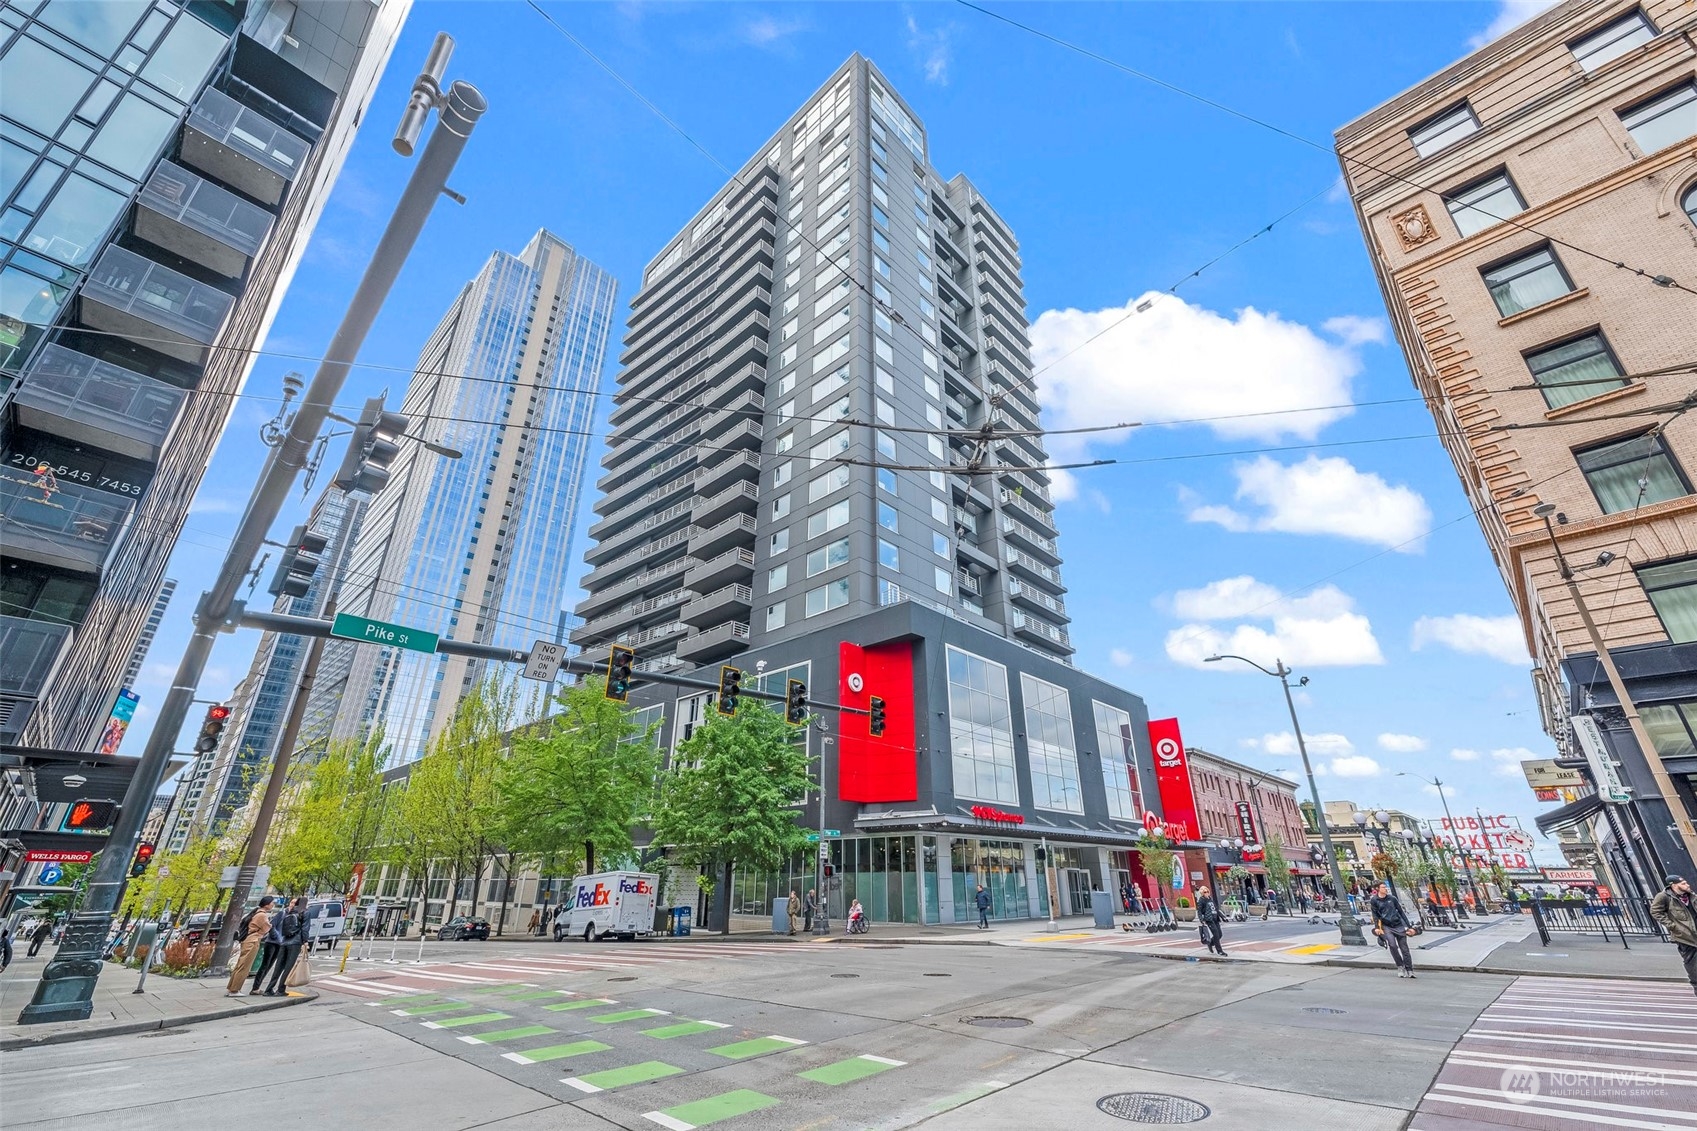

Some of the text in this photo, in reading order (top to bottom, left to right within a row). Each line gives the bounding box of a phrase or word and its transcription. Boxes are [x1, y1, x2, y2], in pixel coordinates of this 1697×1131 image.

[365, 624, 409, 645] Pike St
[542, 645, 557, 654] NO
[537, 653, 556, 663] TURN
[537, 662, 548, 670] ON
[532, 670, 547, 679] RED
[1159, 758, 1182, 768] target
[1536, 790, 1560, 801] COINS
[1441, 814, 1510, 831] PUBLIC
[45, 871, 57, 882] P
[1549, 871, 1593, 879] FARMERS
[619, 879, 653, 895] FedEx
[576, 883, 611, 908] FedEx
